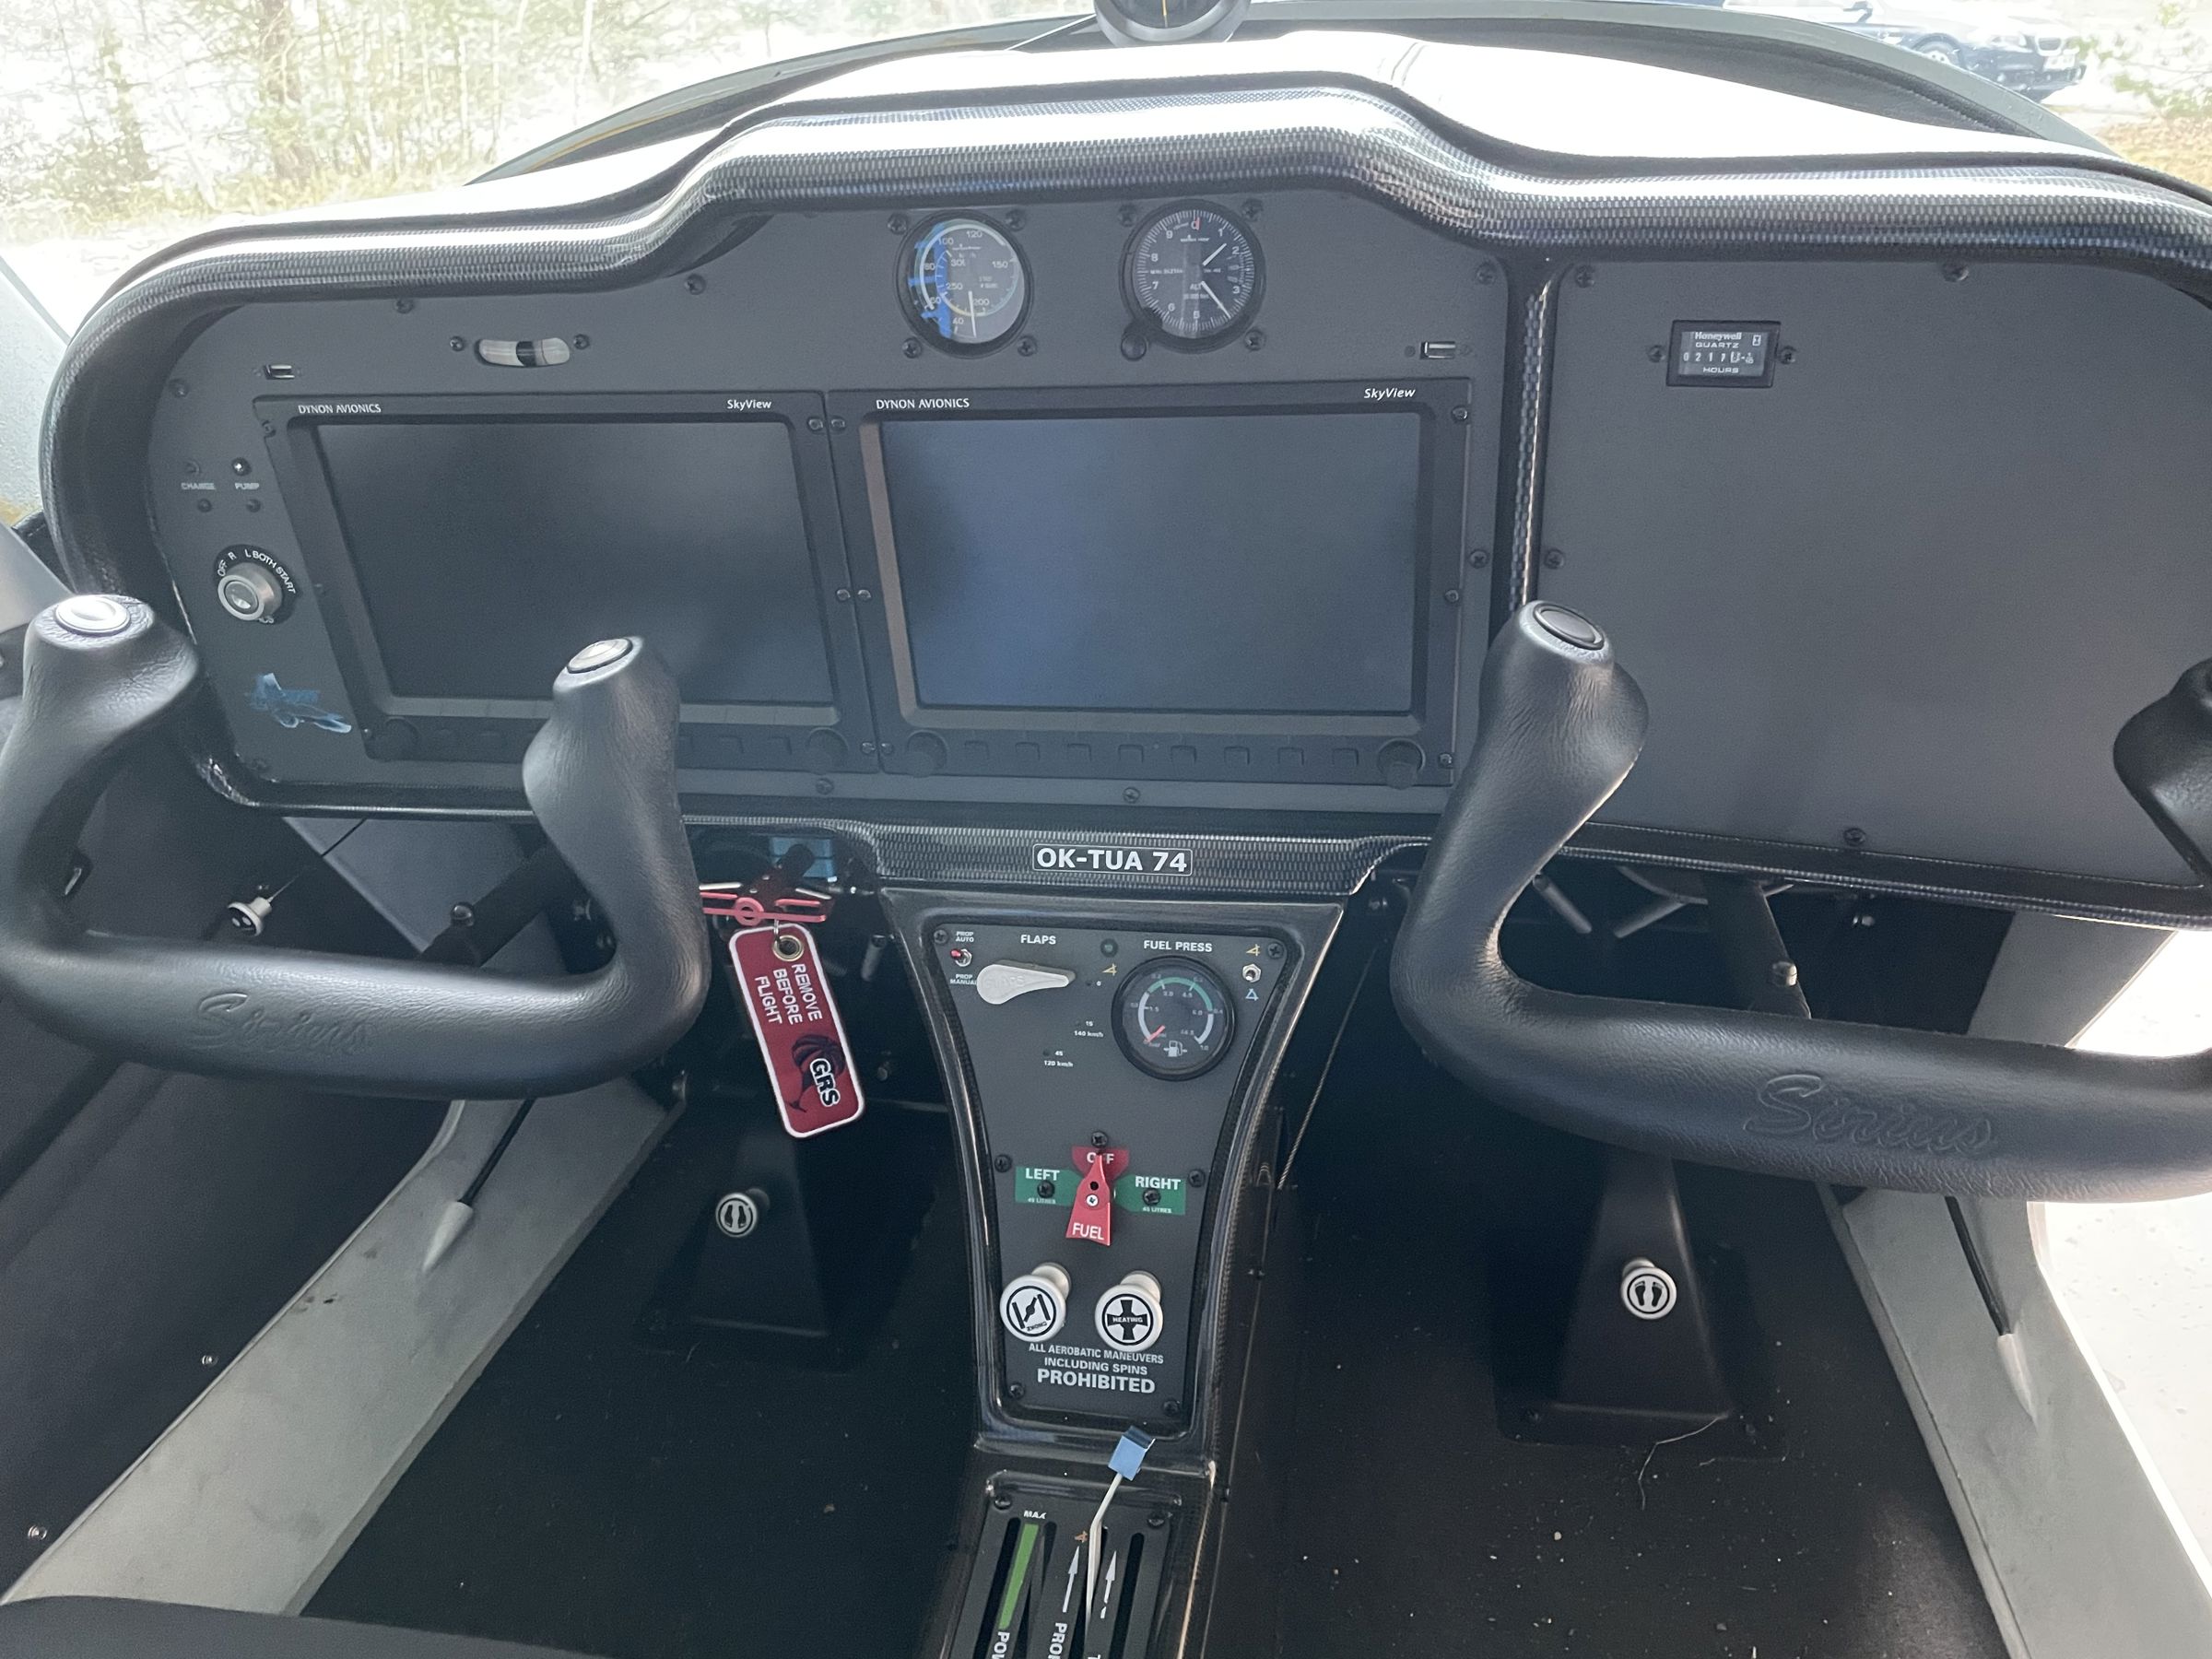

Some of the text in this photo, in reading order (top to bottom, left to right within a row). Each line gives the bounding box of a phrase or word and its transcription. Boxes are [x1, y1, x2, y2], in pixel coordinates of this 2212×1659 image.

[1166, 230, 1173, 239] 9
[1218, 229, 1223, 237] 1
[1231, 246, 1240, 254] 2
[1150, 253, 1159, 262] 8
[1152, 281, 1159, 289] 7
[1232, 286, 1240, 294] 3
[1168, 303, 1175, 312] 6
[1695, 332, 1742, 341] Honeywell
[1364, 387, 1416, 401] SkyView
[298, 404, 382, 414] DYNON AVIONICS
[726, 399, 772, 411] SkyView
[877, 398, 970, 409] DYNON AVIONICS
[217, 548, 296, 594] OFF R L BOTH START
[1037, 847, 1187, 872] OK-TUA 74
[1020, 935, 1056, 945] FLAPS
[1143, 940, 1213, 952] FUEL PRESS
[773, 968, 803, 1025] BEFORE
[791, 963, 822, 1021] REMOVE
[754, 975, 782, 1024] FLIGHT
[810, 1058, 841, 1107] GRS
[1743, 1074, 1997, 1154] Sirius
[1087, 1152, 1114, 1164] OF
[1025, 1168, 1060, 1181] LEFT
[1135, 1176, 1181, 1190] RIGHT
[1072, 1222, 1104, 1241] FUEL
[1029, 1343, 1164, 1364] ALL AEROBATIC MANEUVERS
[1044, 1357, 1147, 1375] INCLUDING SPINS
[1037, 1369, 1156, 1394] PROHIBITED
[1048, 1622, 1068, 1659] PRO
